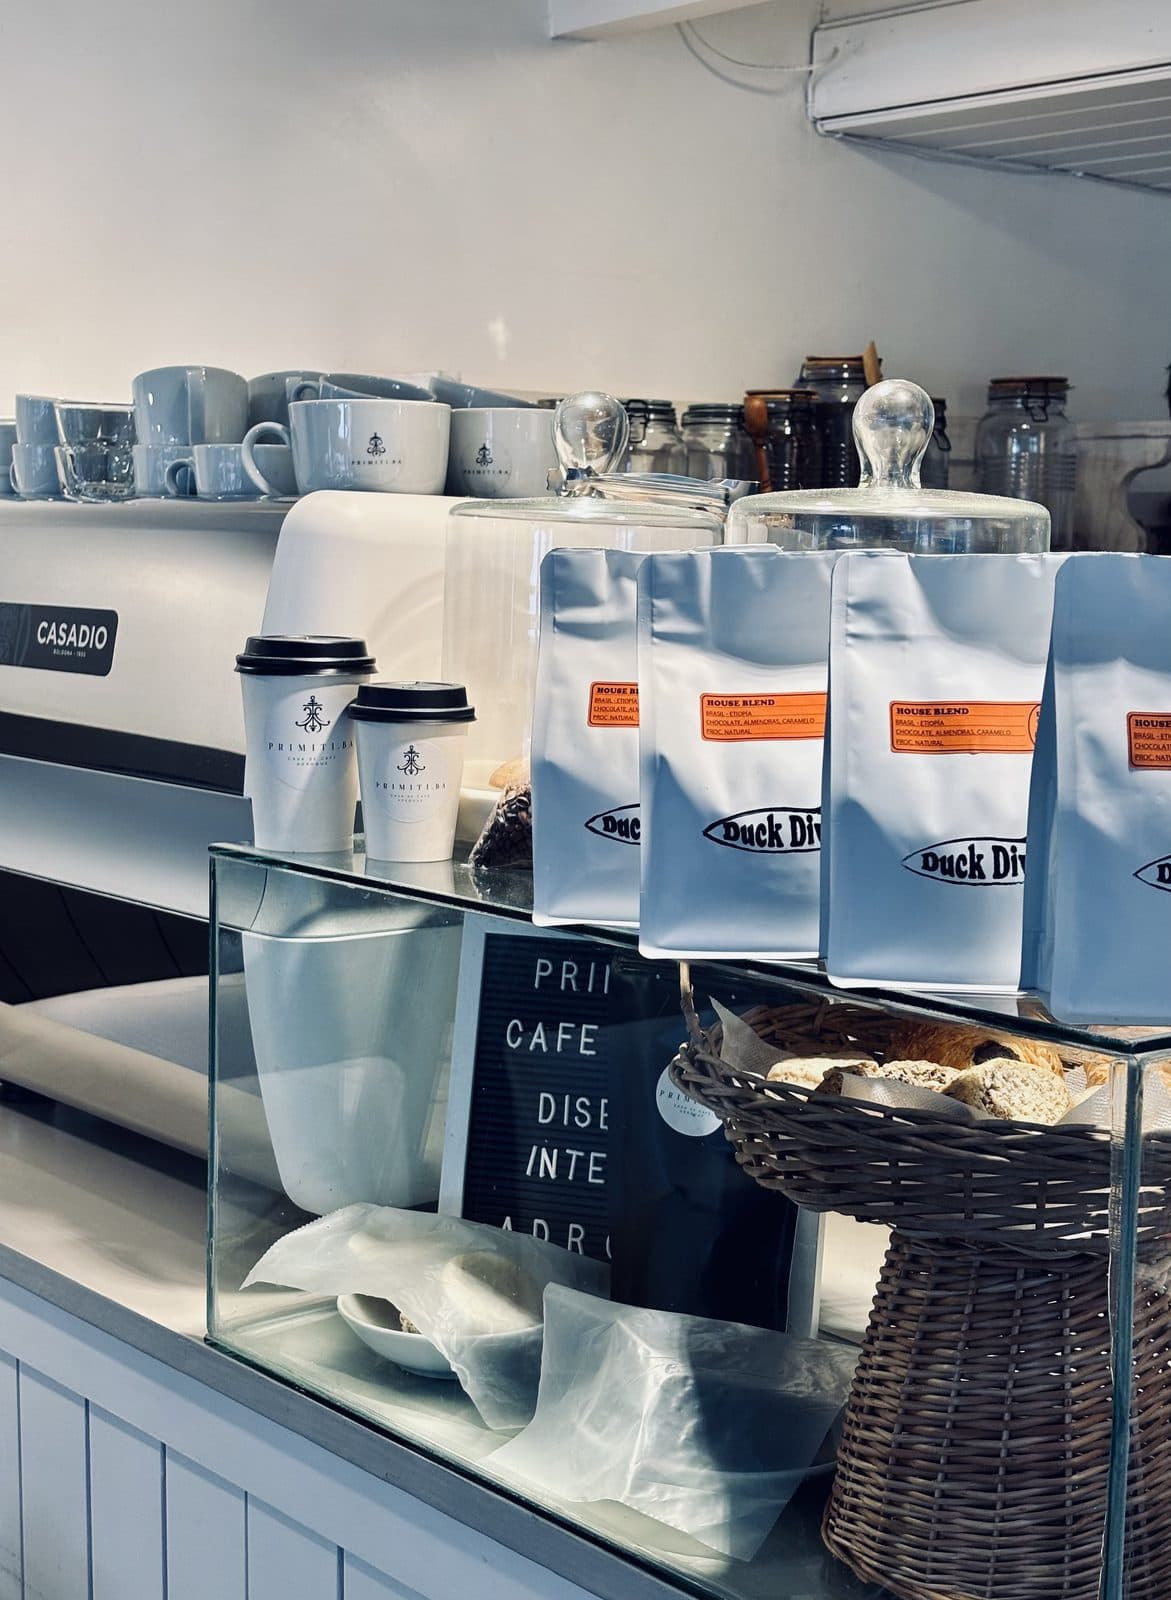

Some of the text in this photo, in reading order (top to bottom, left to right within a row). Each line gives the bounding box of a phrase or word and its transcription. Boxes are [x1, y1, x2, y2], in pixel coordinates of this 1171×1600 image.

[37, 620, 108, 650] CASADIO
[707, 699, 740, 707] HOUSE
[896, 707, 969, 715] HOUSE BLEND
[1135, 719, 1171, 727] HOUSE
[723, 813, 782, 848] Duck
[921, 843, 986, 880] Duck
[506, 1019, 599, 1055] CAFE
[526, 1145, 607, 1184] INTE
